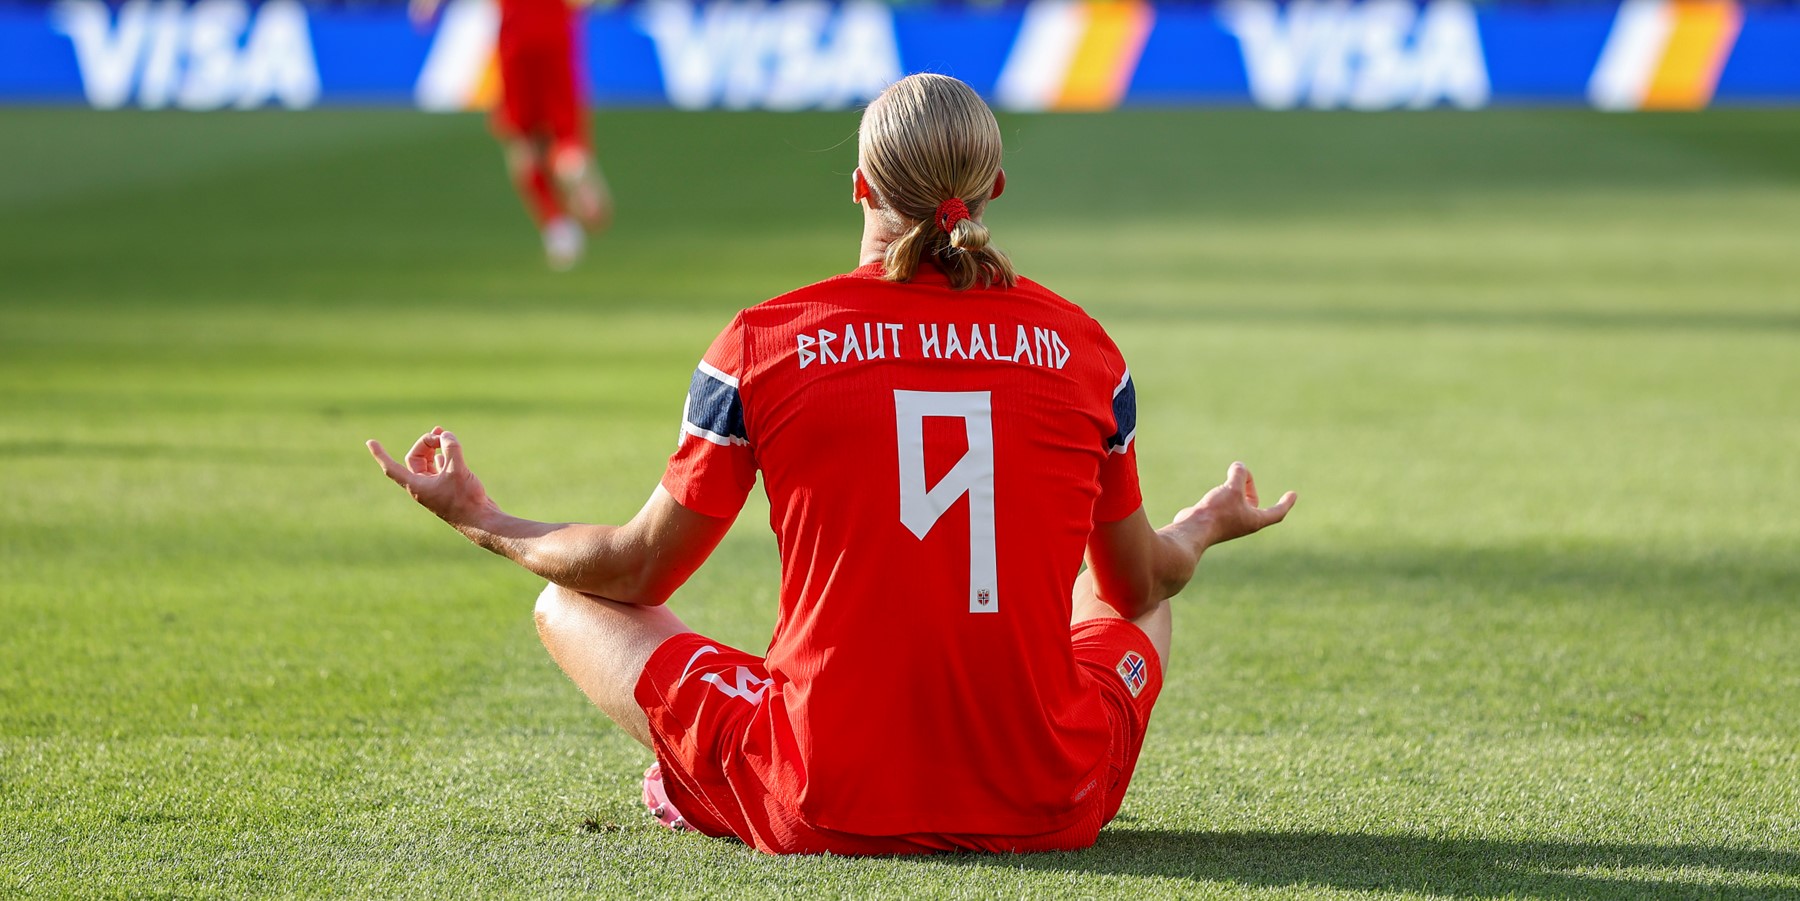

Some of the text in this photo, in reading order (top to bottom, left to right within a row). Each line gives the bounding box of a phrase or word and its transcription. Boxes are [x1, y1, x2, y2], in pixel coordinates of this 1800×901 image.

[55, 0, 319, 111] VISA
[638, 0, 901, 111] VISA
[1221, 0, 1489, 111] VISA
[797, 322, 1071, 370] BRAUT HAALAND
[893, 389, 999, 614] 9
